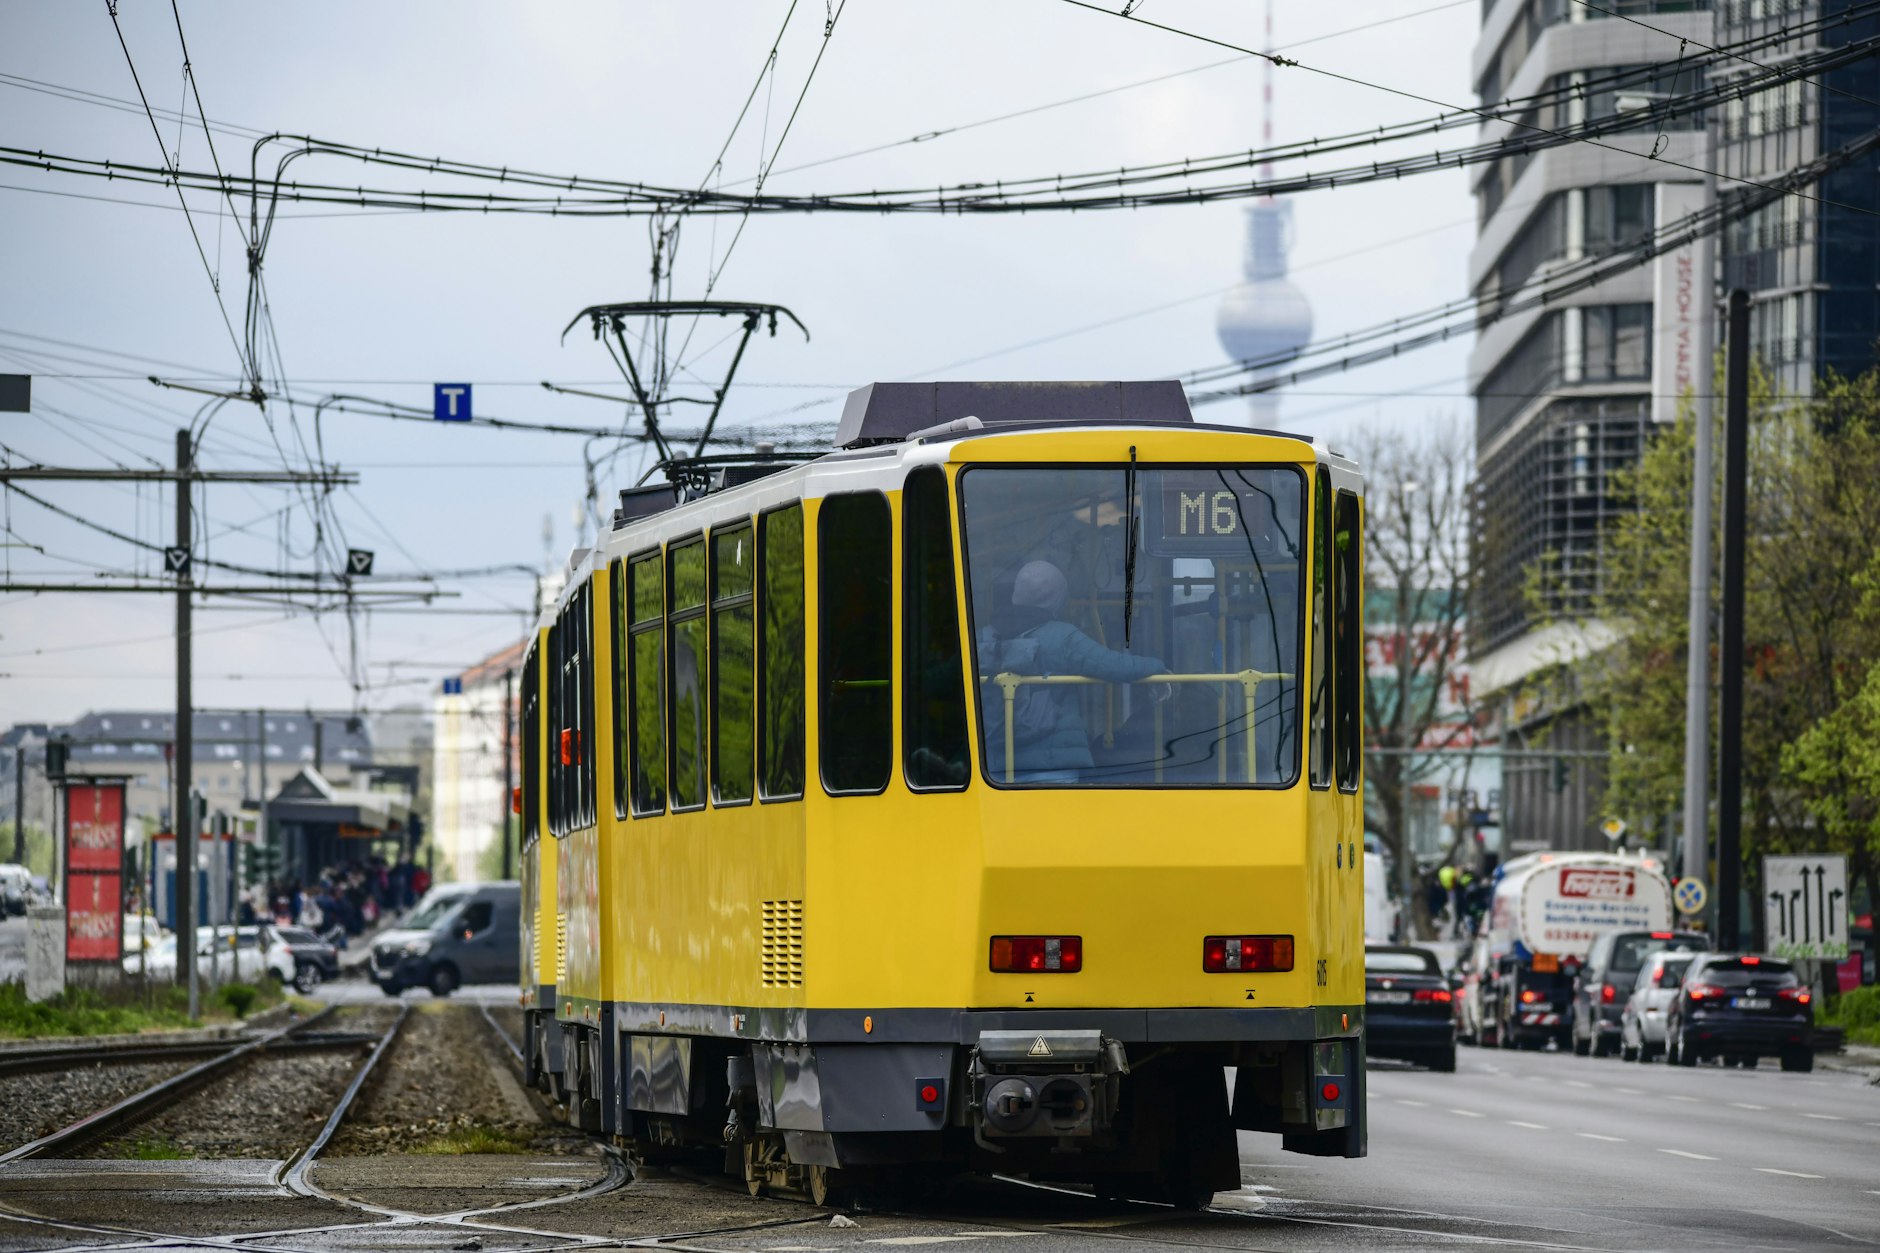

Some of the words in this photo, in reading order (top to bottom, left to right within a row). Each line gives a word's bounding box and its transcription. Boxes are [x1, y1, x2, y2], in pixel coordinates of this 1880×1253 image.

[1677, 256, 1692, 322] HOUSE
[442, 388, 465, 416] T
[1180, 491, 1236, 534] M6
